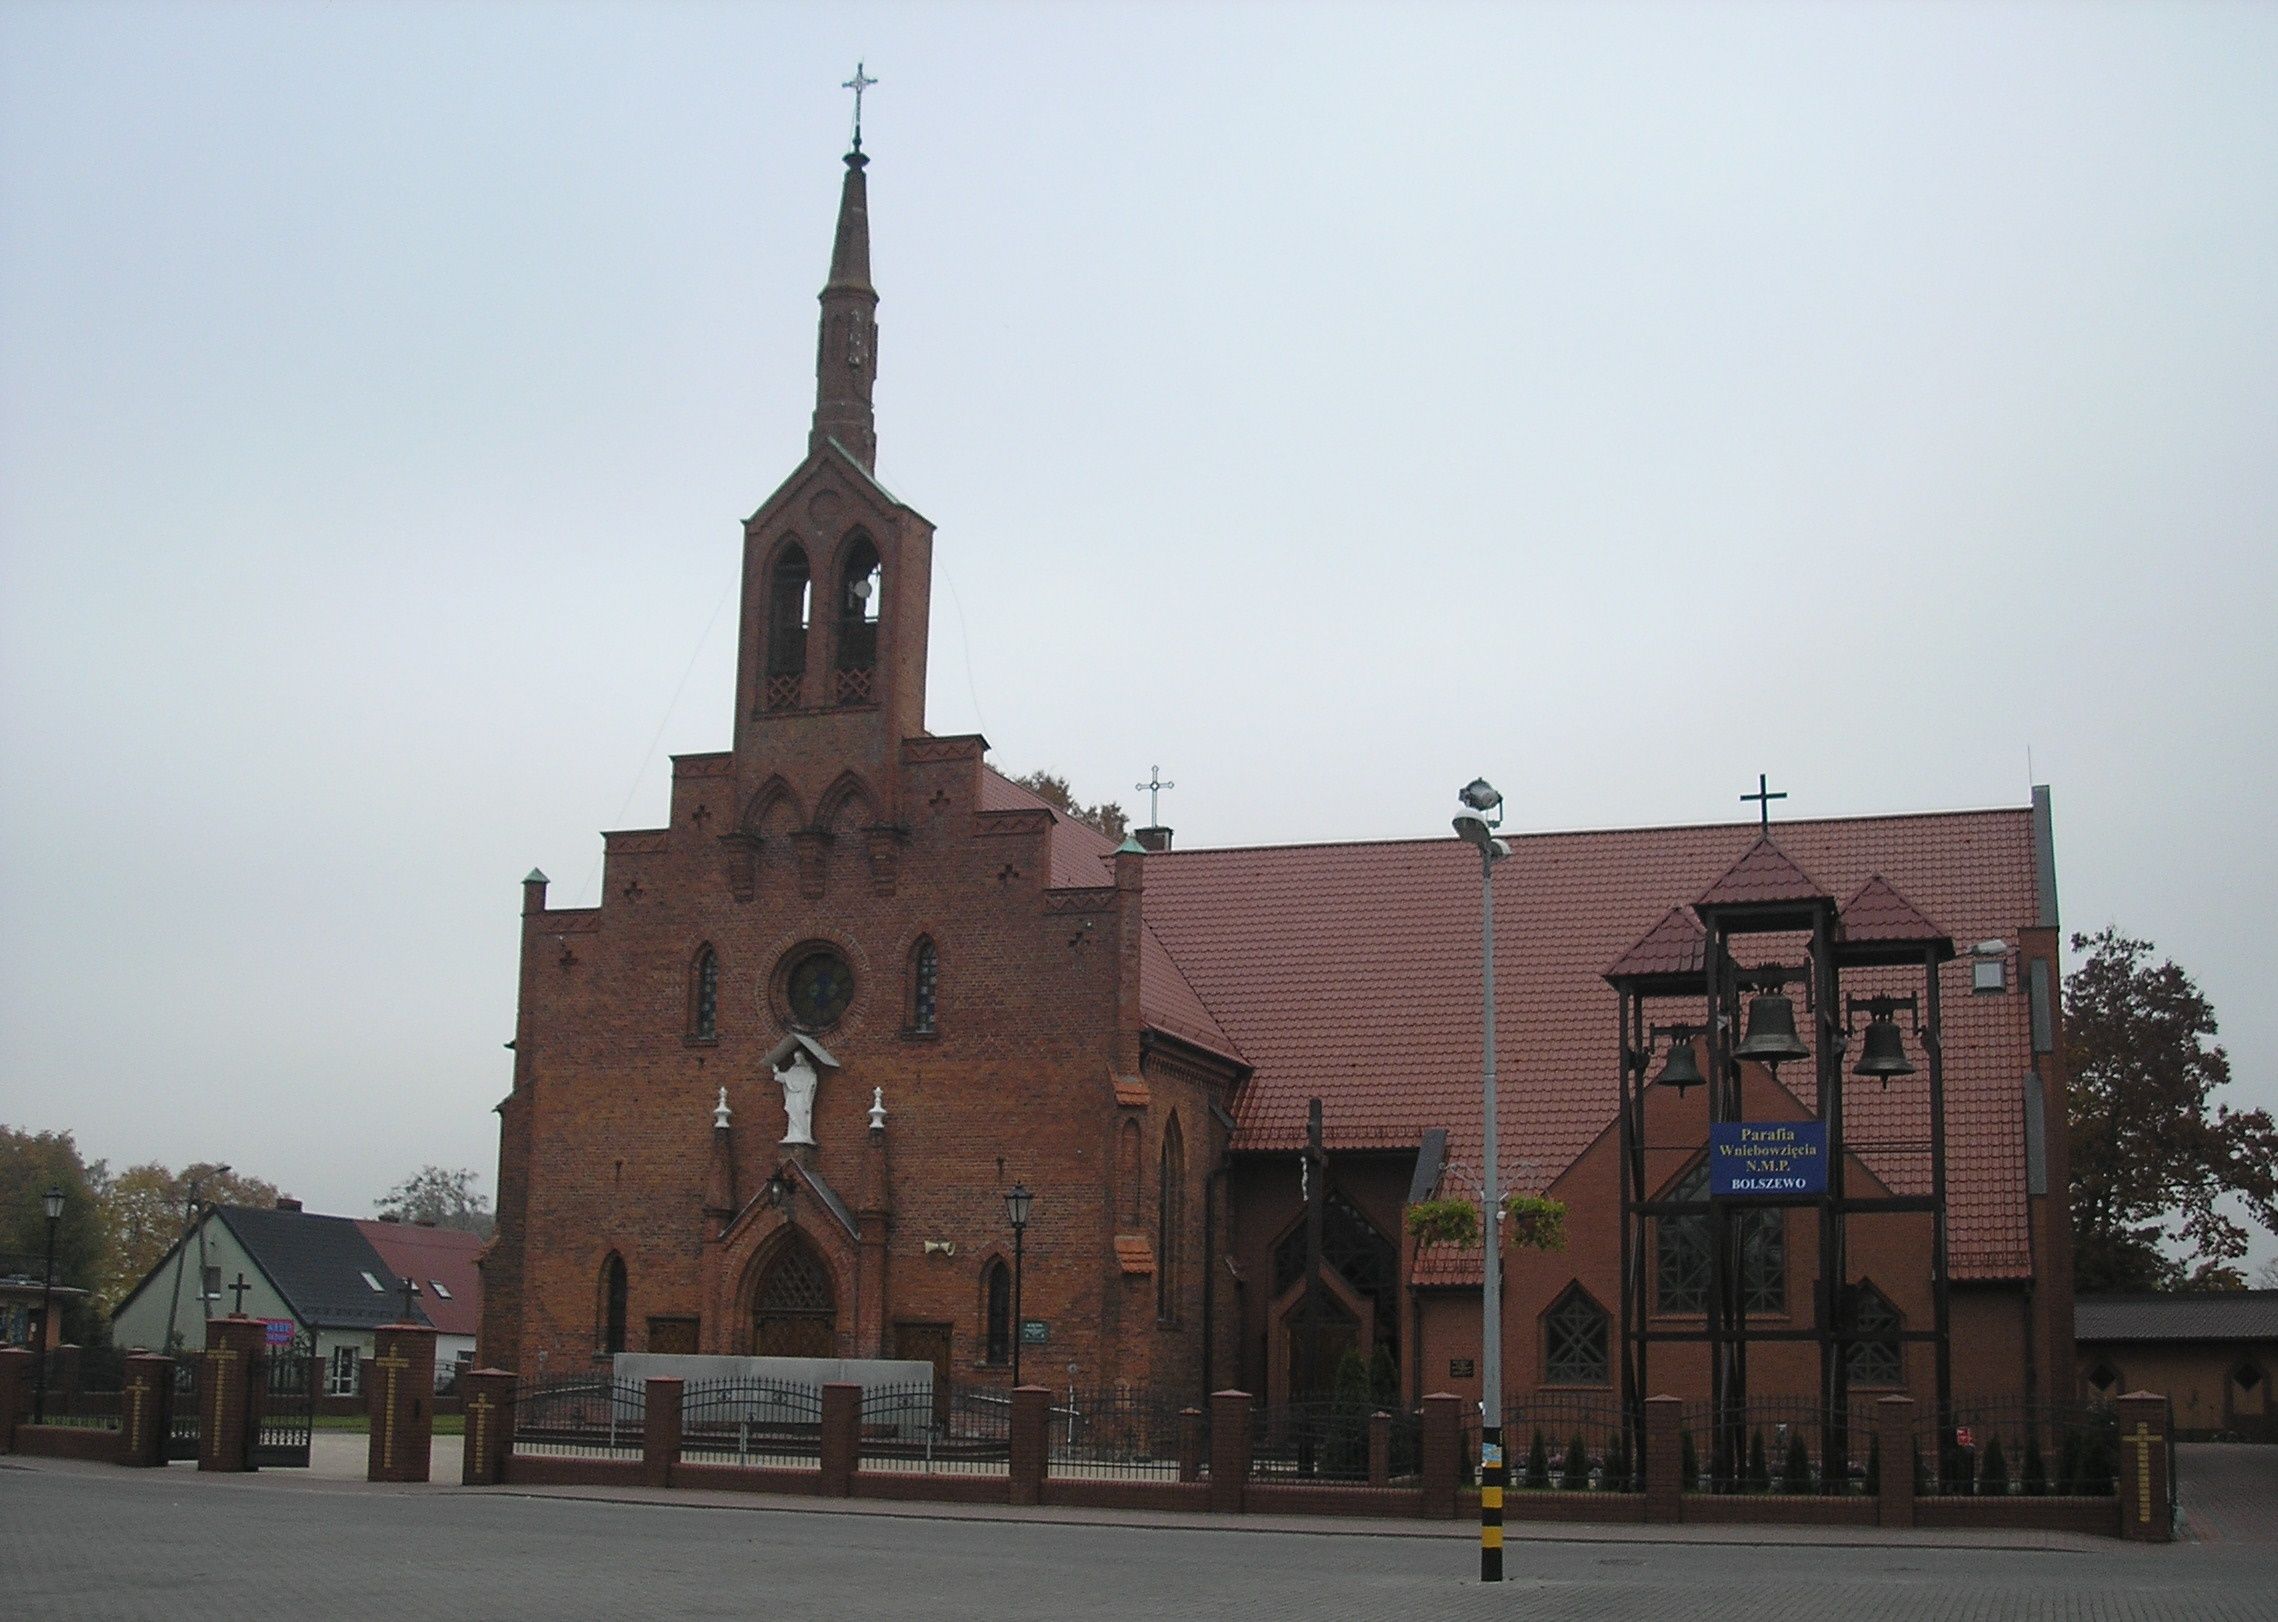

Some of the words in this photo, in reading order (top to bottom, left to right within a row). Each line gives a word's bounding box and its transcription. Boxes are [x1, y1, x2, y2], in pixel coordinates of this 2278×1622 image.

[1741, 1128, 1795, 1141] Parafia
[1719, 1143, 1817, 1158] Wniebowzięcia
[1746, 1160, 1790, 1172] N.M.P.
[1731, 1178, 1806, 1190] BOLSZEWO
